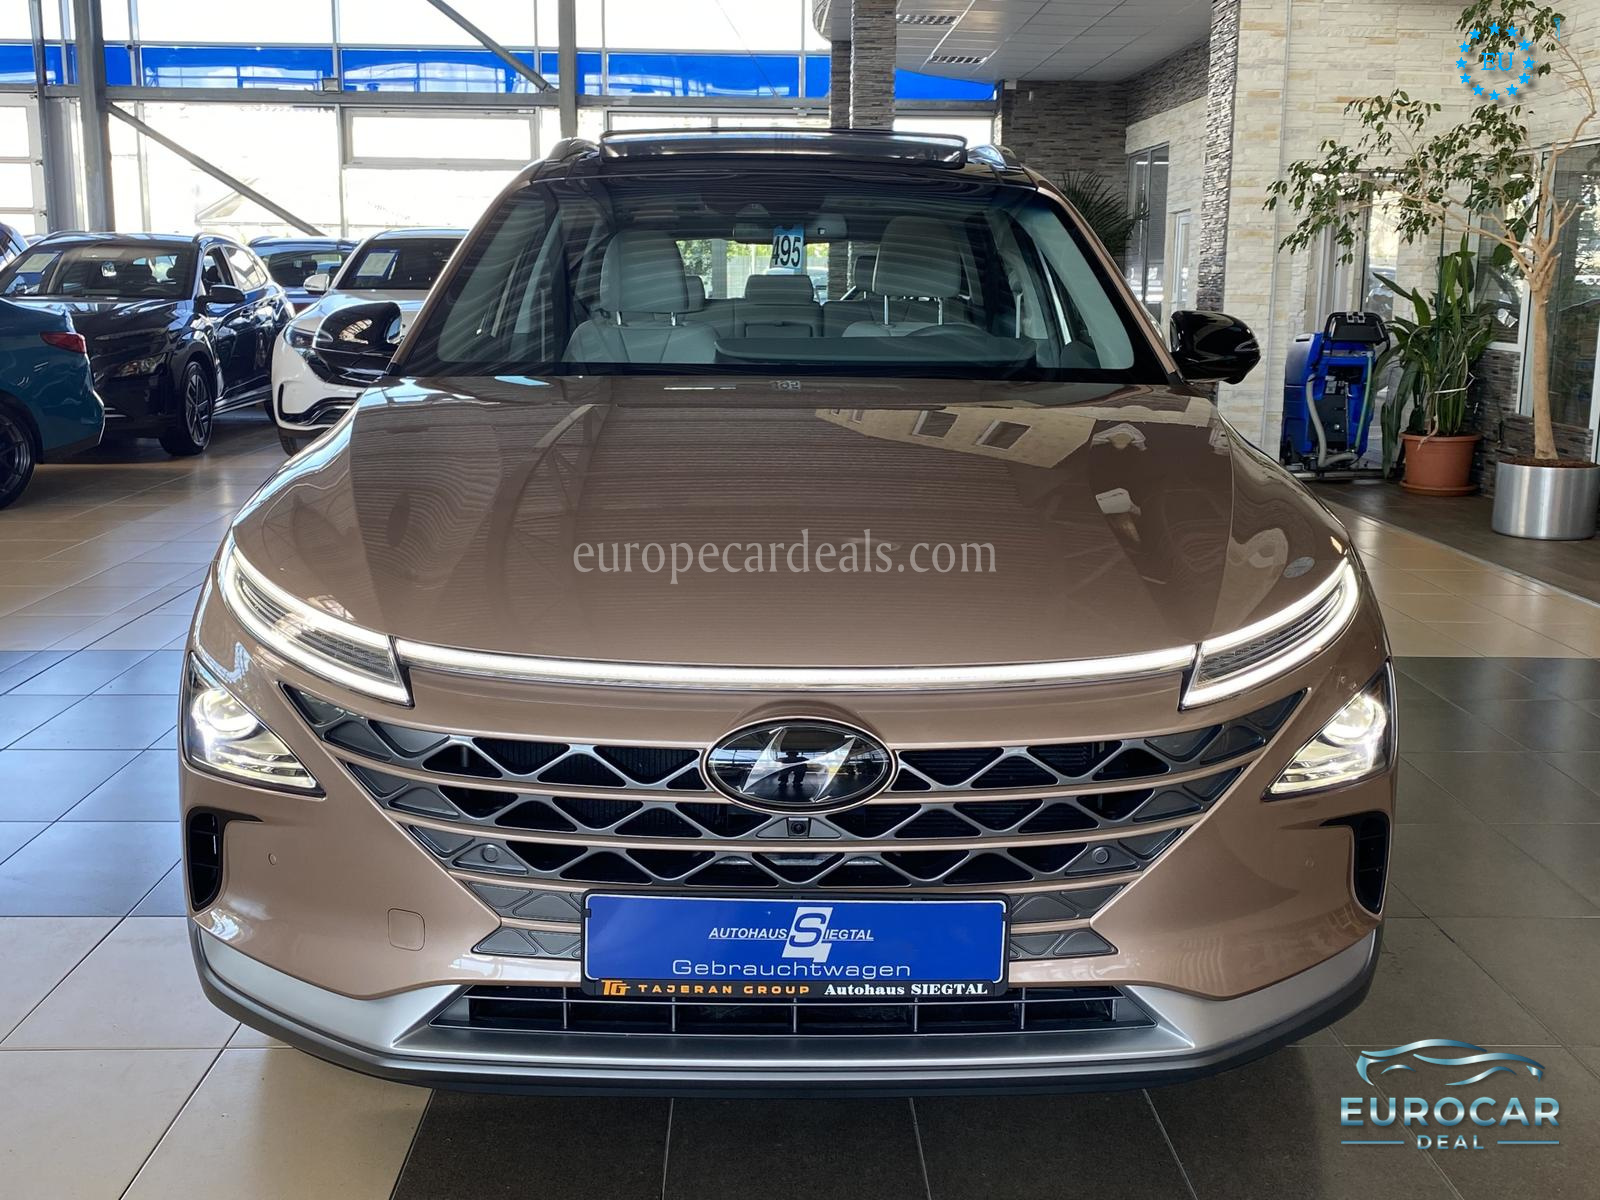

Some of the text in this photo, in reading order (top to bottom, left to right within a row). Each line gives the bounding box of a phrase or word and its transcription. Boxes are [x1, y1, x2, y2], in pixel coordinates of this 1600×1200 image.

[772, 235, 802, 267] 495
[708, 927, 788, 940] AUTOHAUS
[672, 959, 911, 980] Gebrauchtwagen
[638, 983, 733, 995] TAJERAN
[743, 984, 811, 995] GROUP
[824, 983, 906, 996] Autohaus
[910, 983, 989, 996] SIEGTAL
